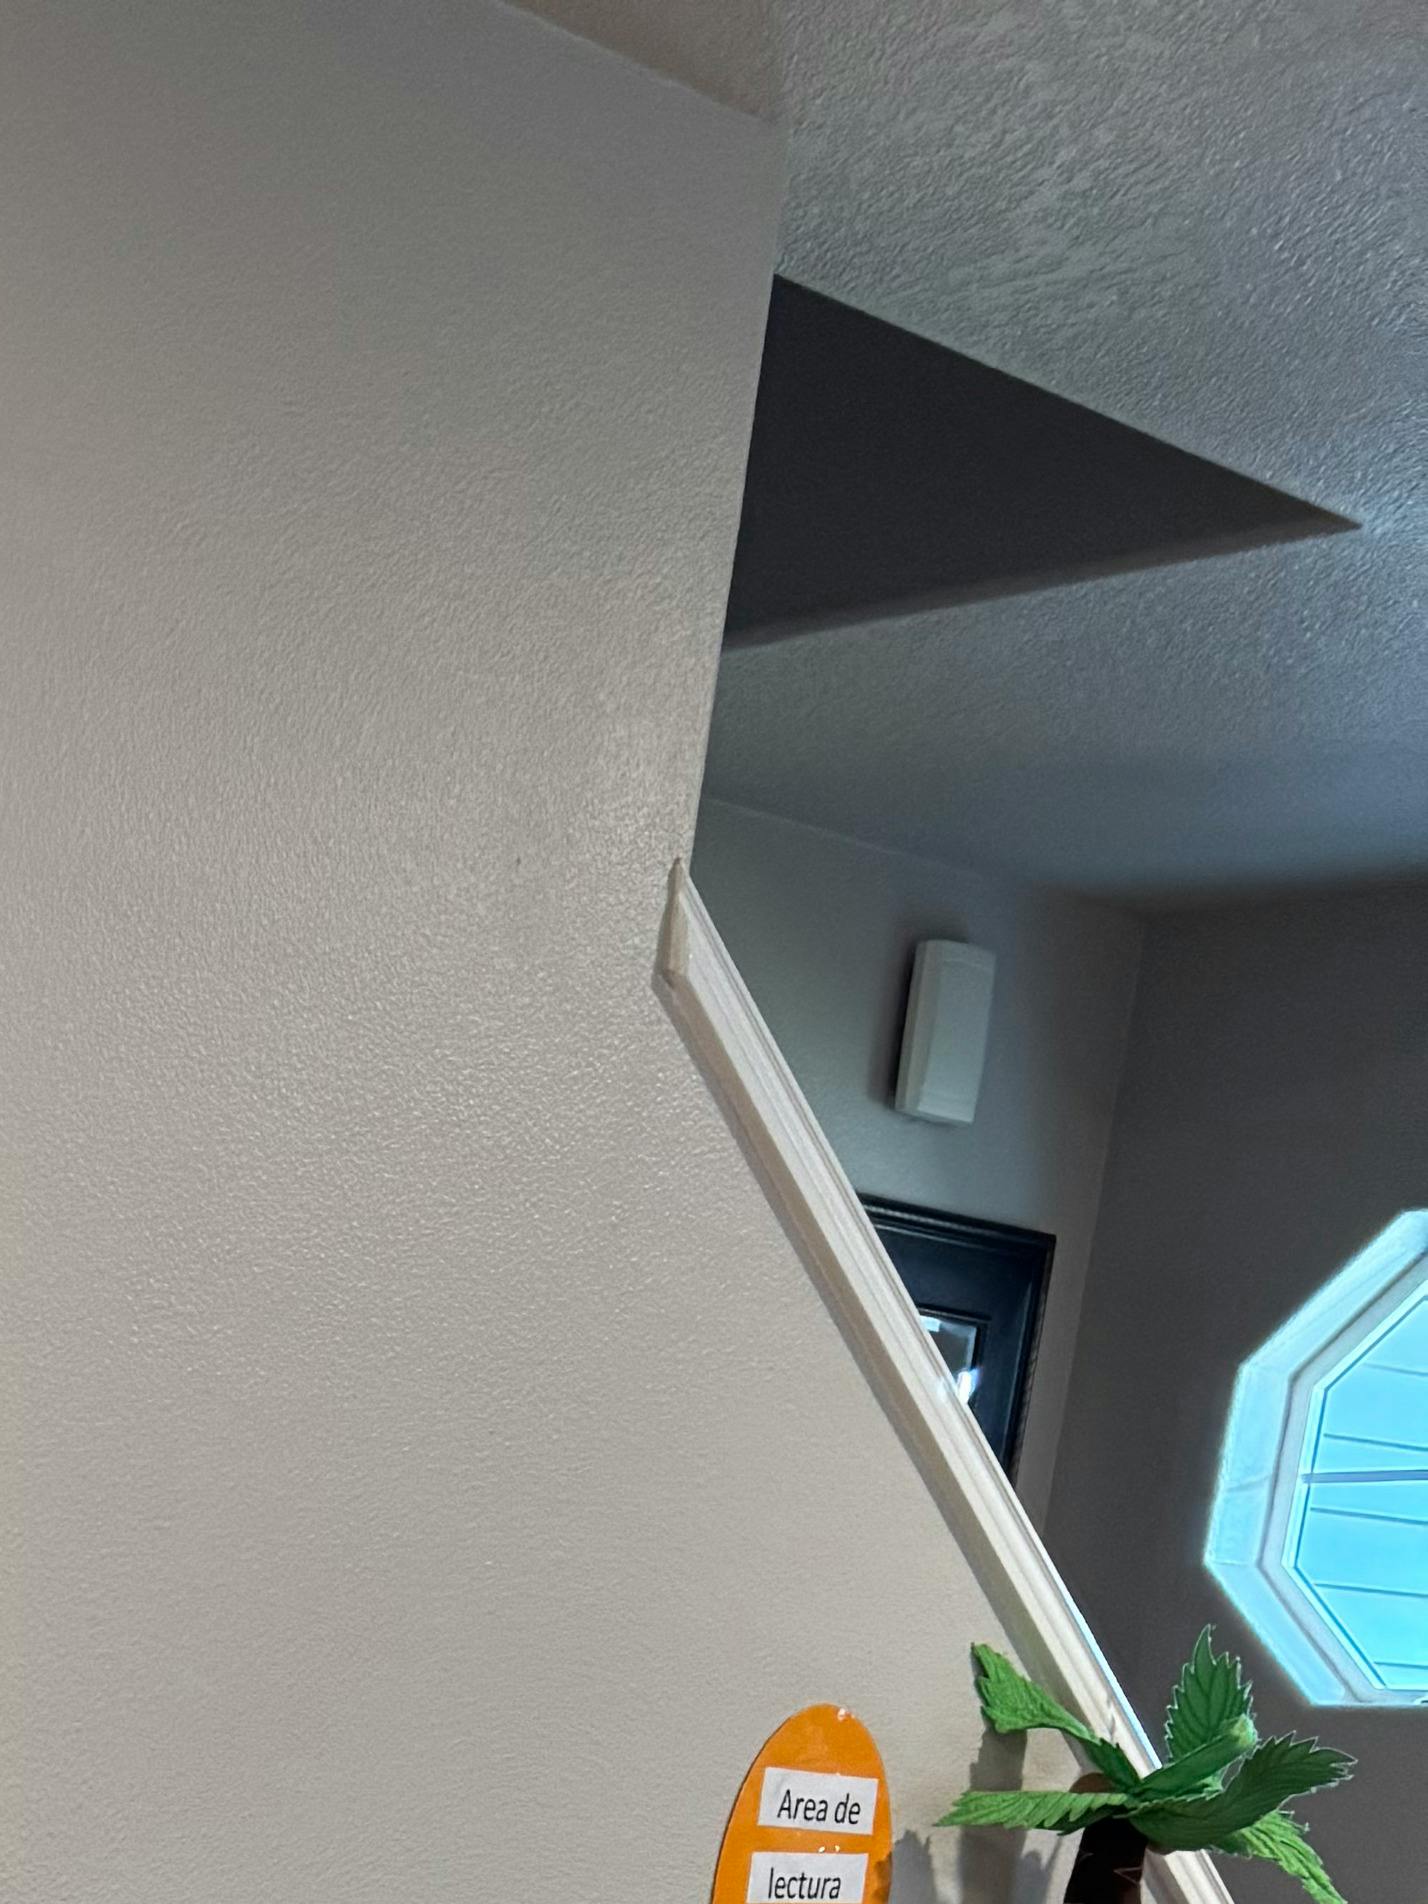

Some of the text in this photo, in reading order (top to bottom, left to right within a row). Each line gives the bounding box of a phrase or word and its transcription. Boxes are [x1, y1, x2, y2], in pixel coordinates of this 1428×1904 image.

[777, 1789, 861, 1825] Area de
[768, 1867, 841, 1900] lectura
